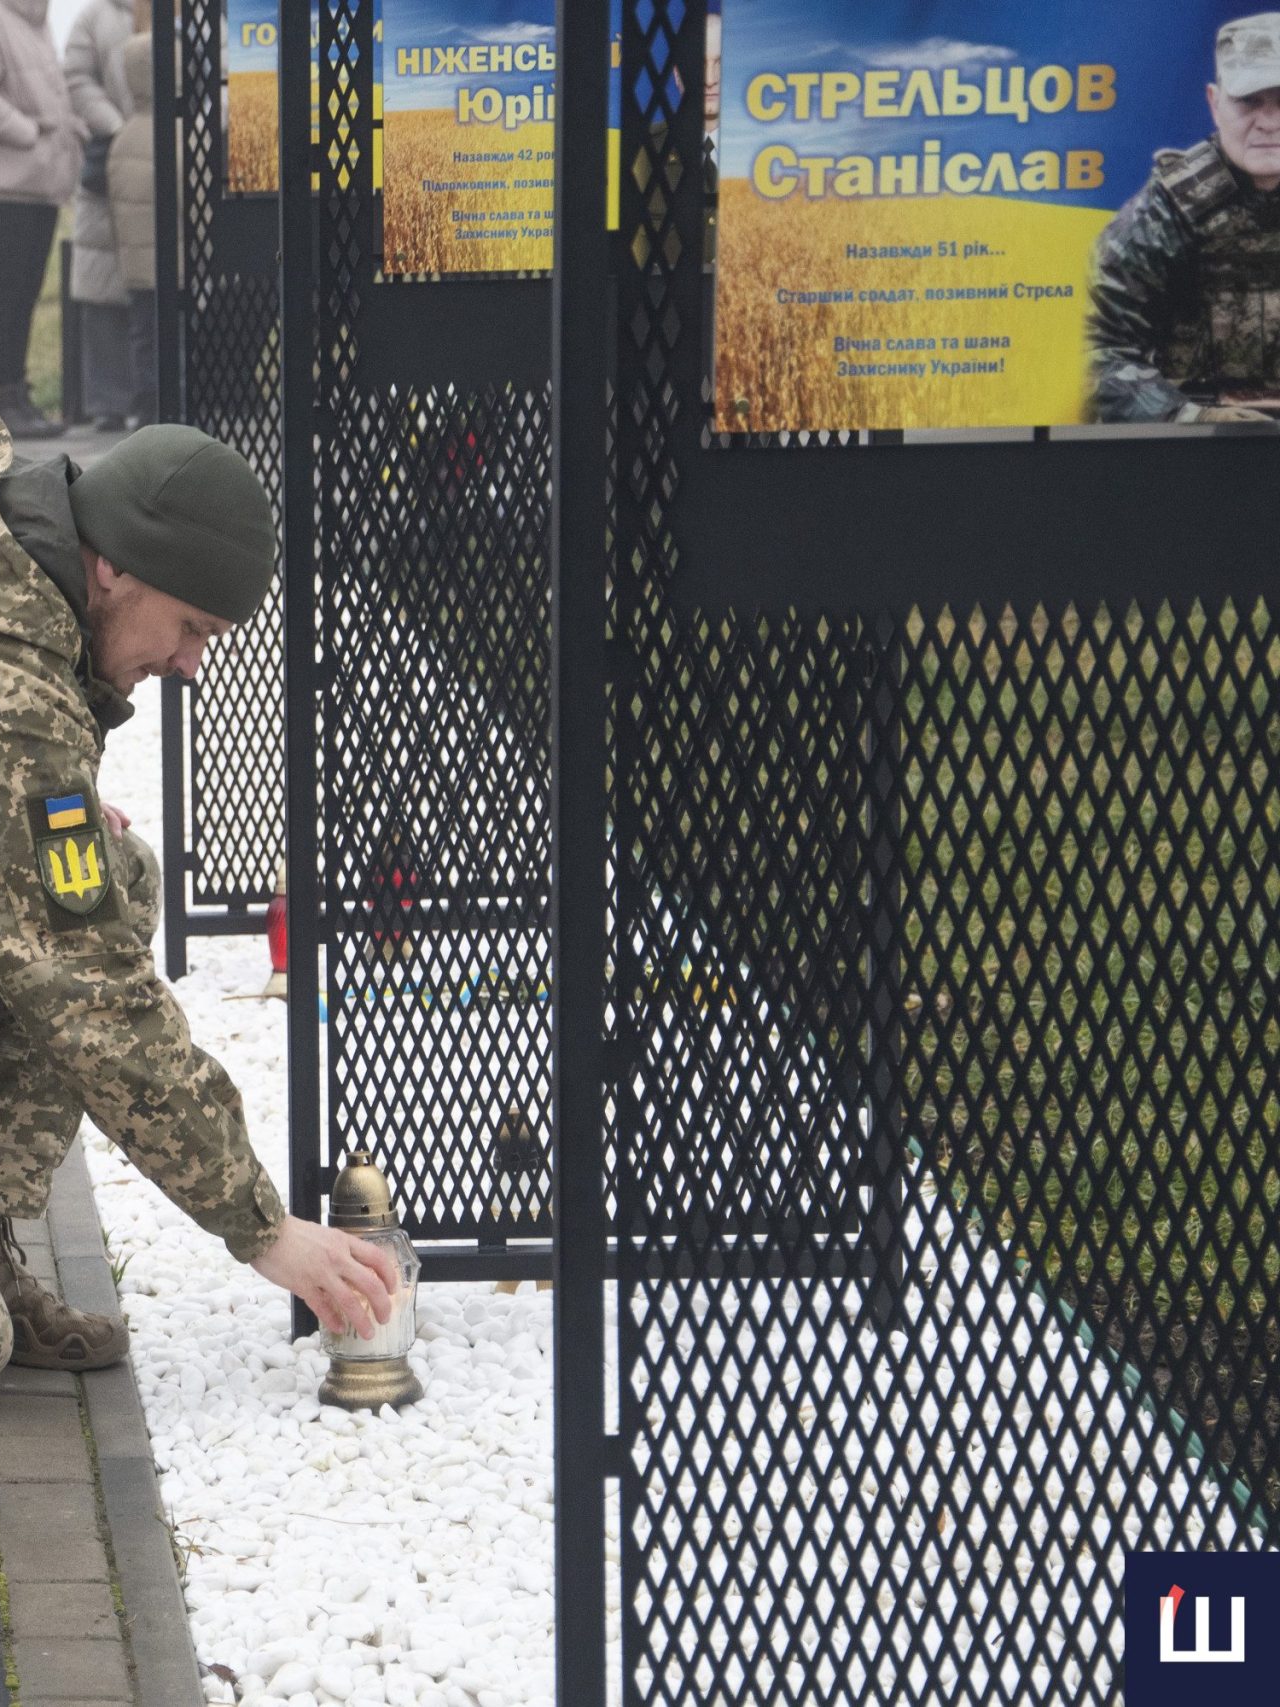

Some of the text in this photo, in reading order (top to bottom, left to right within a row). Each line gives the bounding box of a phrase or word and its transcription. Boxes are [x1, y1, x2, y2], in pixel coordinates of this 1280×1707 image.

[396, 43, 556, 75] НІЖЕНСЬ
[746, 63, 1117, 124] СТРЕЛЬЦОВ
[453, 151, 514, 164] Назавжди
[517, 149, 533, 161] 42
[753, 139, 1105, 199] Станіслав
[452, 210, 487, 222] Вічна
[489, 211, 525, 221] слава
[528, 210, 542, 220] та
[455, 228, 518, 241] Захиснику
[845, 244, 933, 260] Назавжди
[937, 241, 958, 257] 51
[777, 287, 854, 306] Старший
[924, 284, 1009, 301] позивний
[833, 335, 1011, 352] Вічна слава та шана
[836, 357, 1005, 379] Захиснику України!
